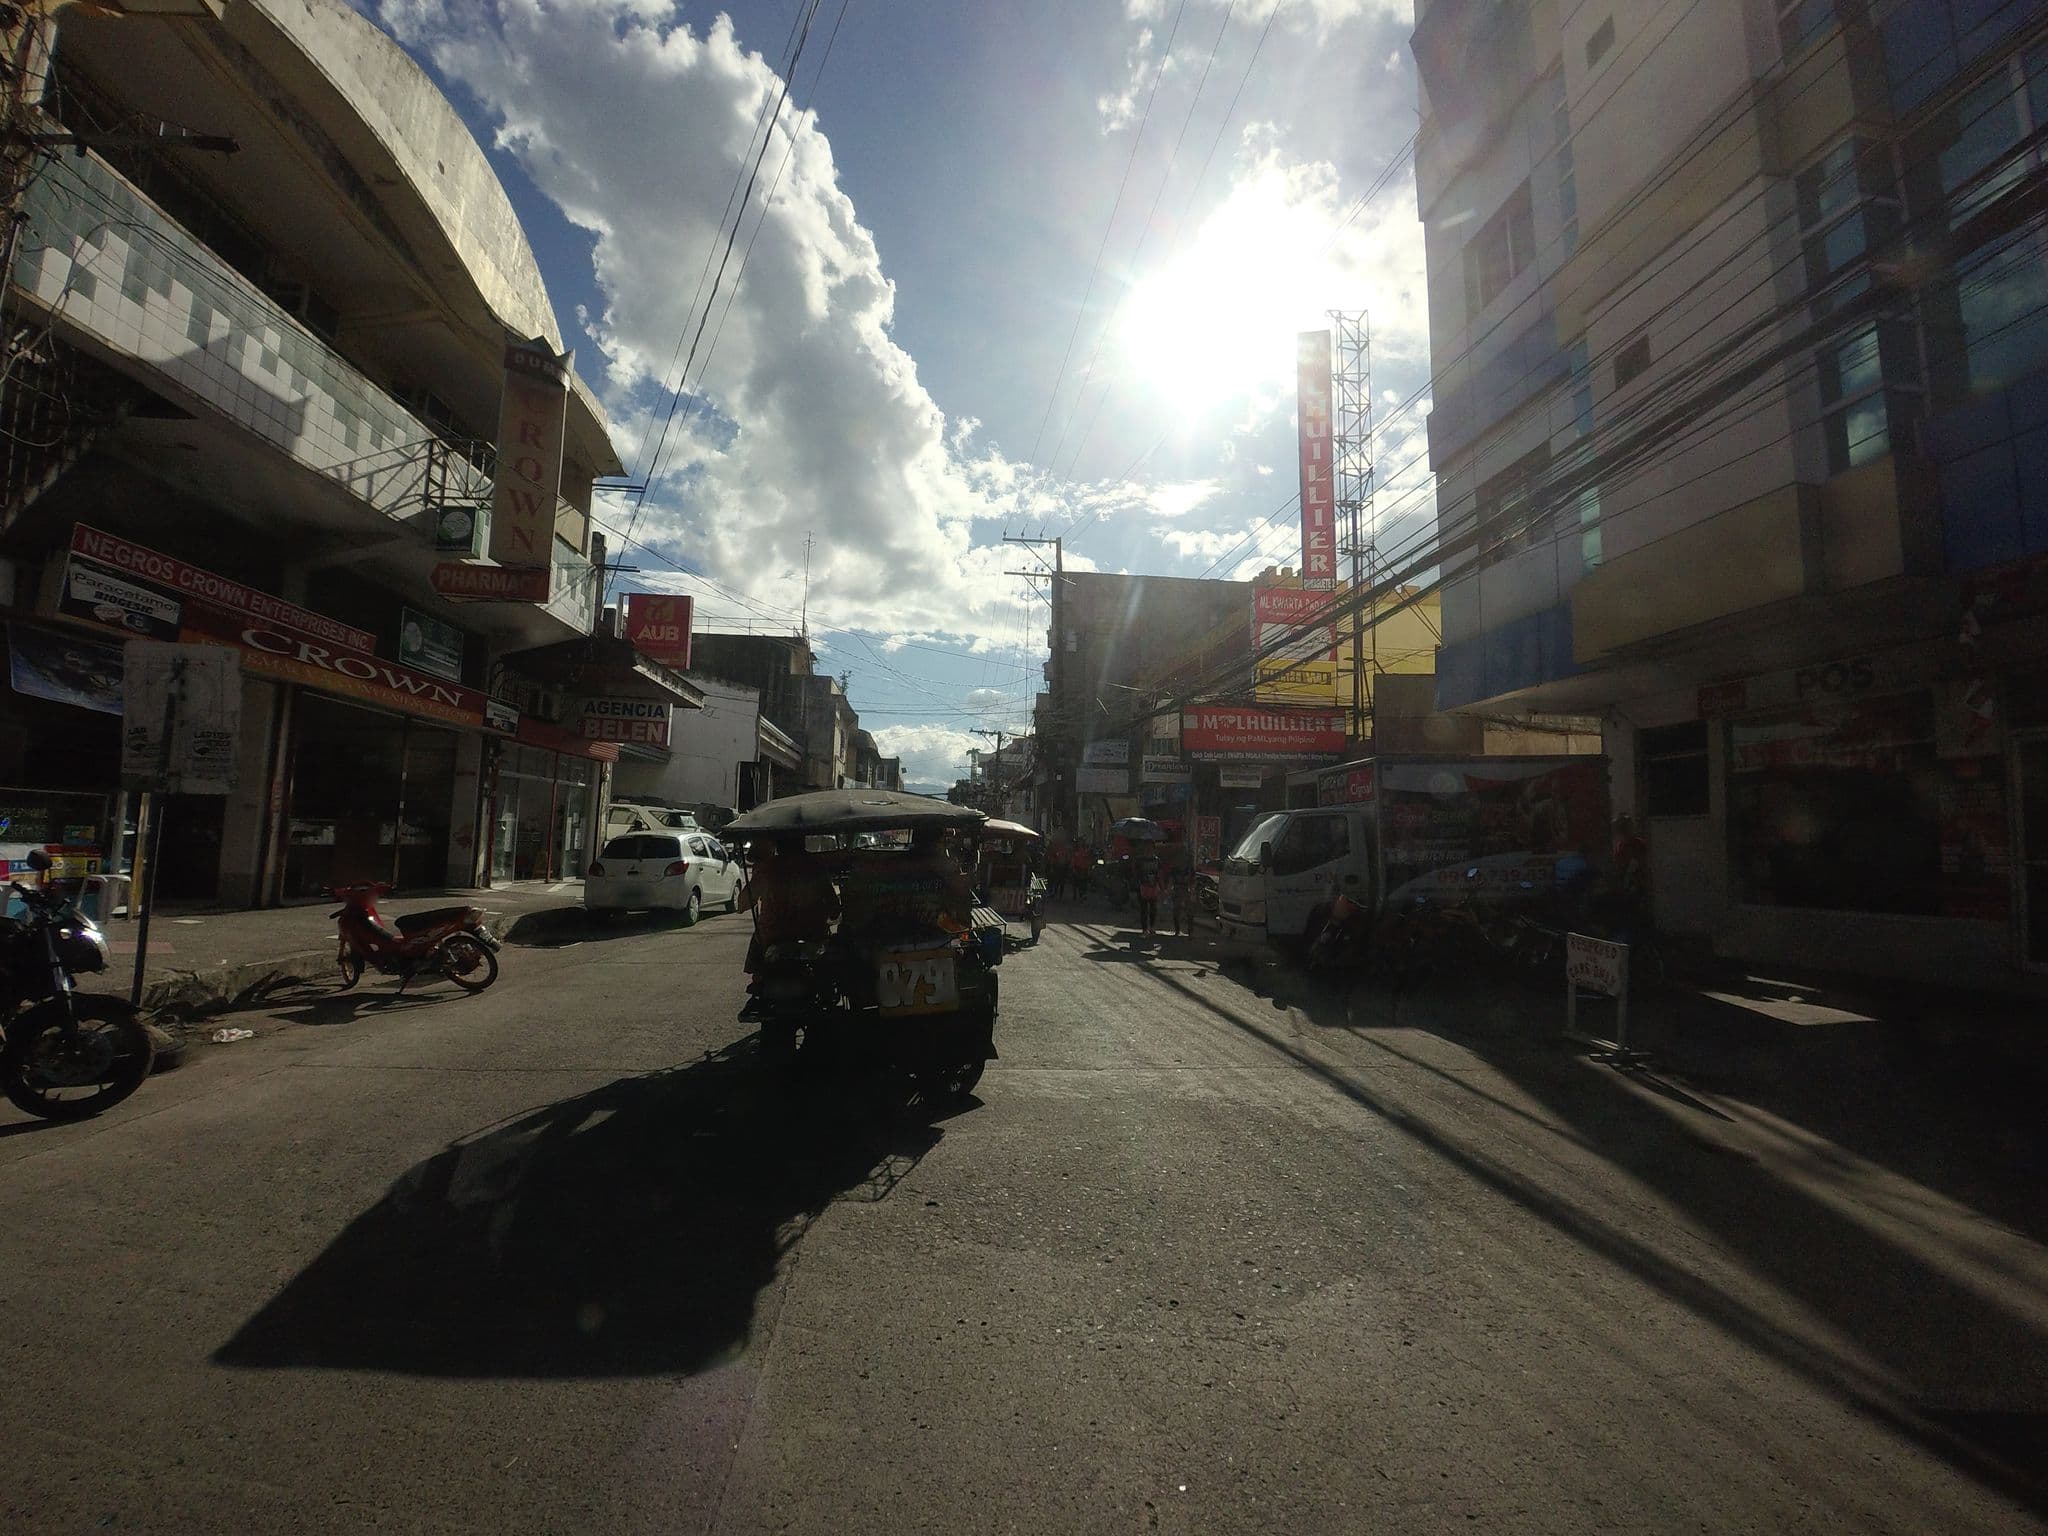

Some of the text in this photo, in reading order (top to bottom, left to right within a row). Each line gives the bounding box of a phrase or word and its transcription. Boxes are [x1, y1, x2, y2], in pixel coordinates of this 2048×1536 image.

[74, 573, 177, 614] Paracetamol
[83, 532, 175, 579] NEGROS
[178, 568, 248, 606] CROWN
[250, 592, 346, 643] ENTERPRISES
[636, 624, 680, 641] AUB
[241, 629, 464, 707] CROWN
[584, 702, 665, 718] AGENCIA
[583, 718, 666, 743] BELEN
